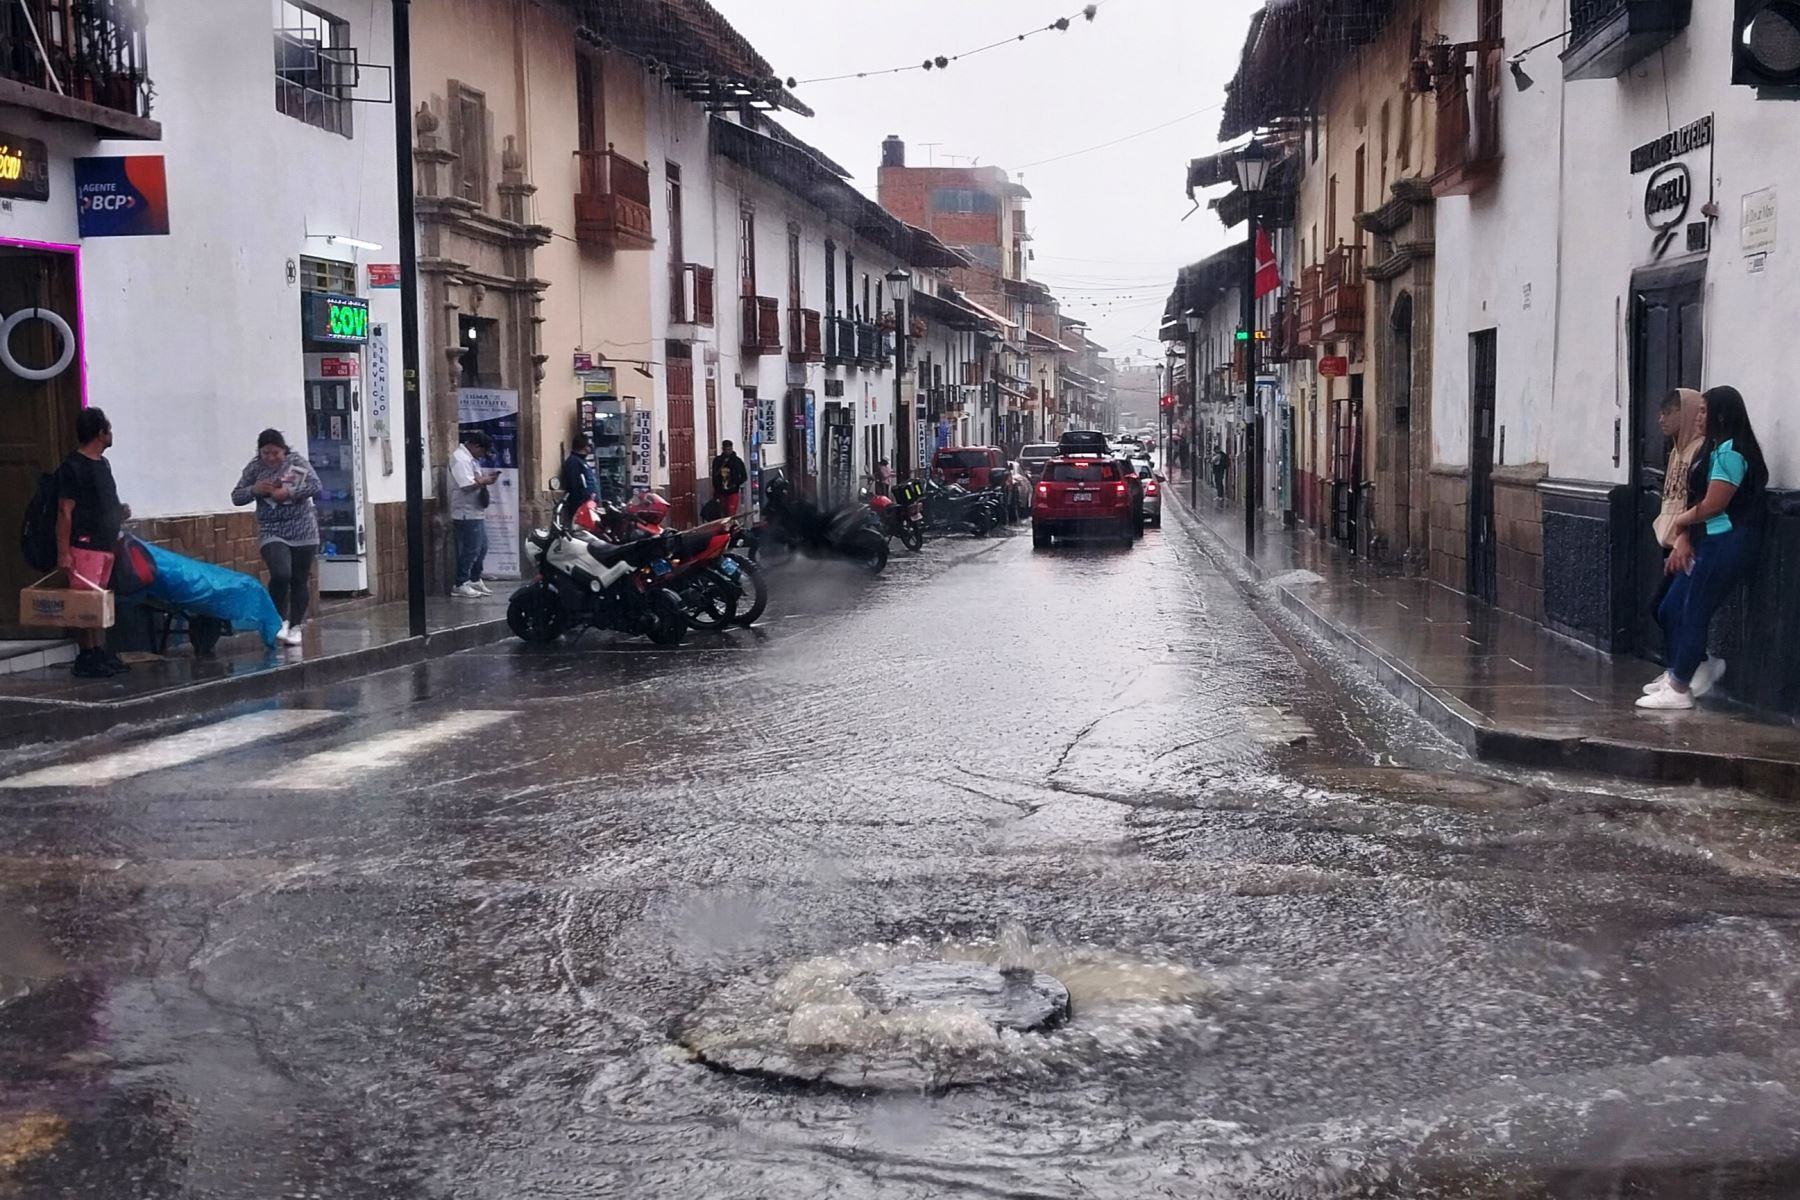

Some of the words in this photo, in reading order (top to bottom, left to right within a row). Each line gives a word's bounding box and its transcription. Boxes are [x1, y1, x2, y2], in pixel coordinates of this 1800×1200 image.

[83, 183, 116, 191] AGENTE
[92, 195, 126, 210] BCP
[642, 412, 650, 474] HIDROGEL
